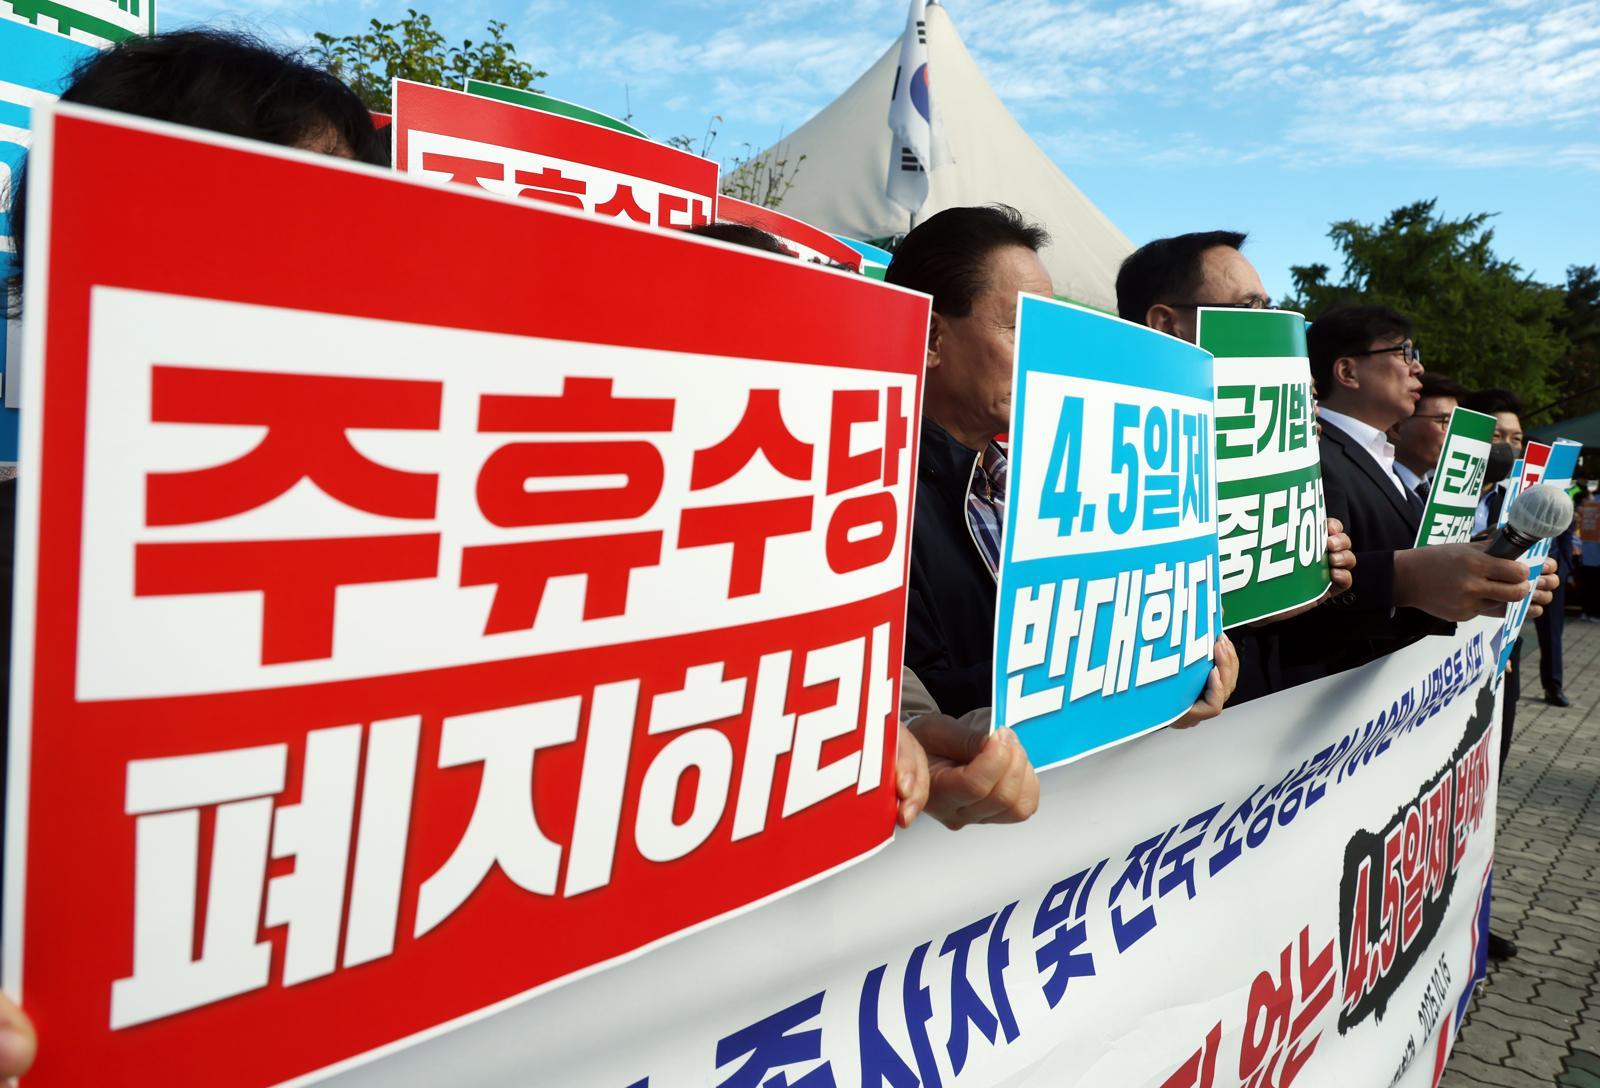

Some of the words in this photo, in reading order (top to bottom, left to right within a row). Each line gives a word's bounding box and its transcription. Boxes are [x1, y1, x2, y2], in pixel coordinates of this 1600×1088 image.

[1037, 395, 1209, 537] 4.5일제
[1216, 383, 1308, 460] 근기법
[134, 376, 907, 666] 주휴수당
[1218, 478, 1328, 595] 중단하
[1005, 553, 1217, 727] 반대한다
[110, 622, 893, 1030] 폐지하라
[1032, 857, 1109, 1010] 및
[1109, 803, 1225, 955] 전국
[1343, 766, 1454, 1015] 4.5일제
